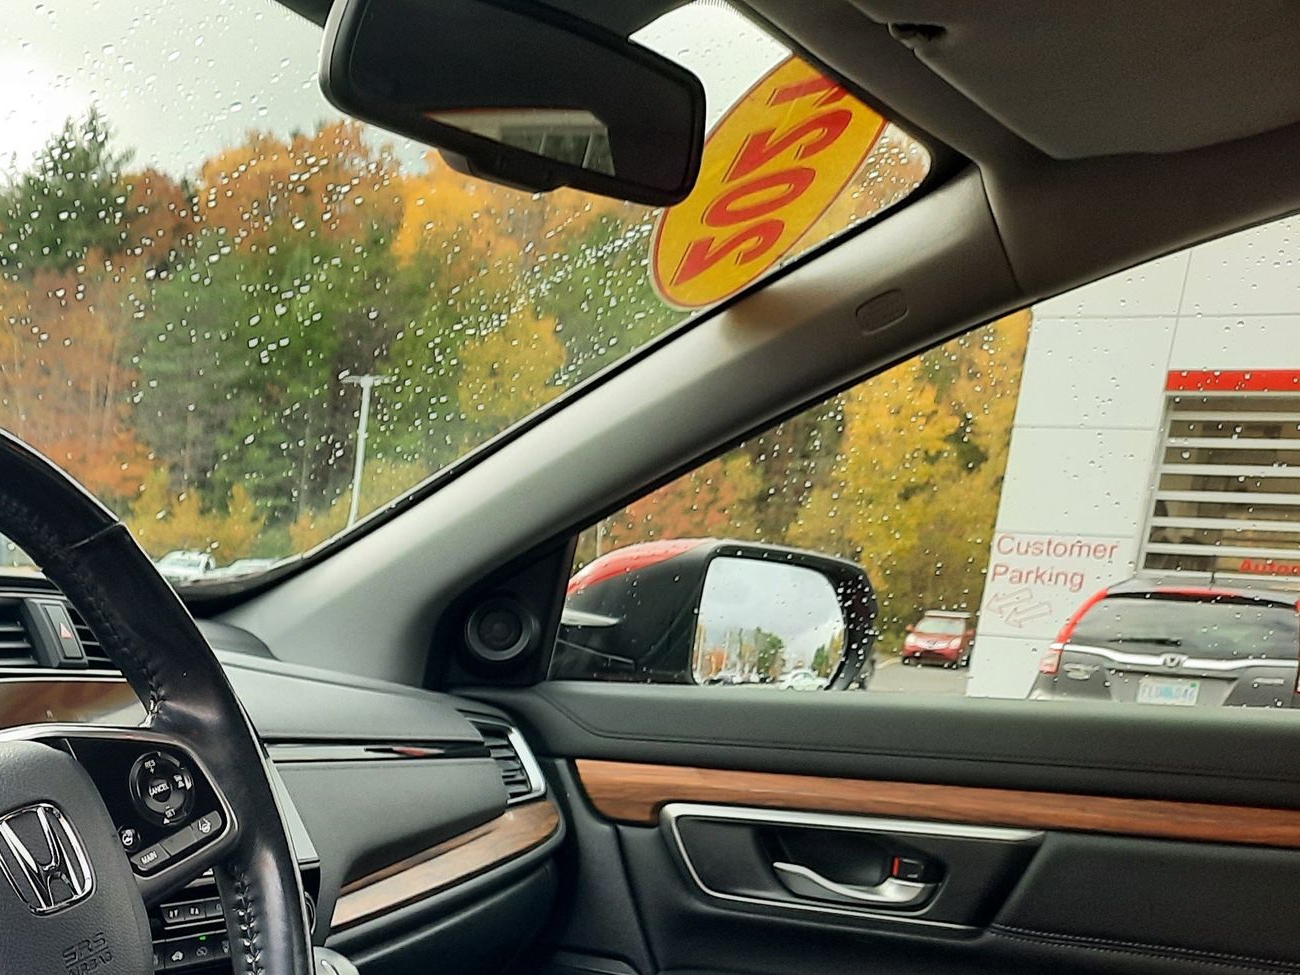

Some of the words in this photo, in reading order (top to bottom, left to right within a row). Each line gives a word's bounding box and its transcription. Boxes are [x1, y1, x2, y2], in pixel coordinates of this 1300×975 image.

[997, 534, 1119, 560] Customer
[991, 563, 1086, 593] Parking
[140, 851, 157, 864] MAIN
